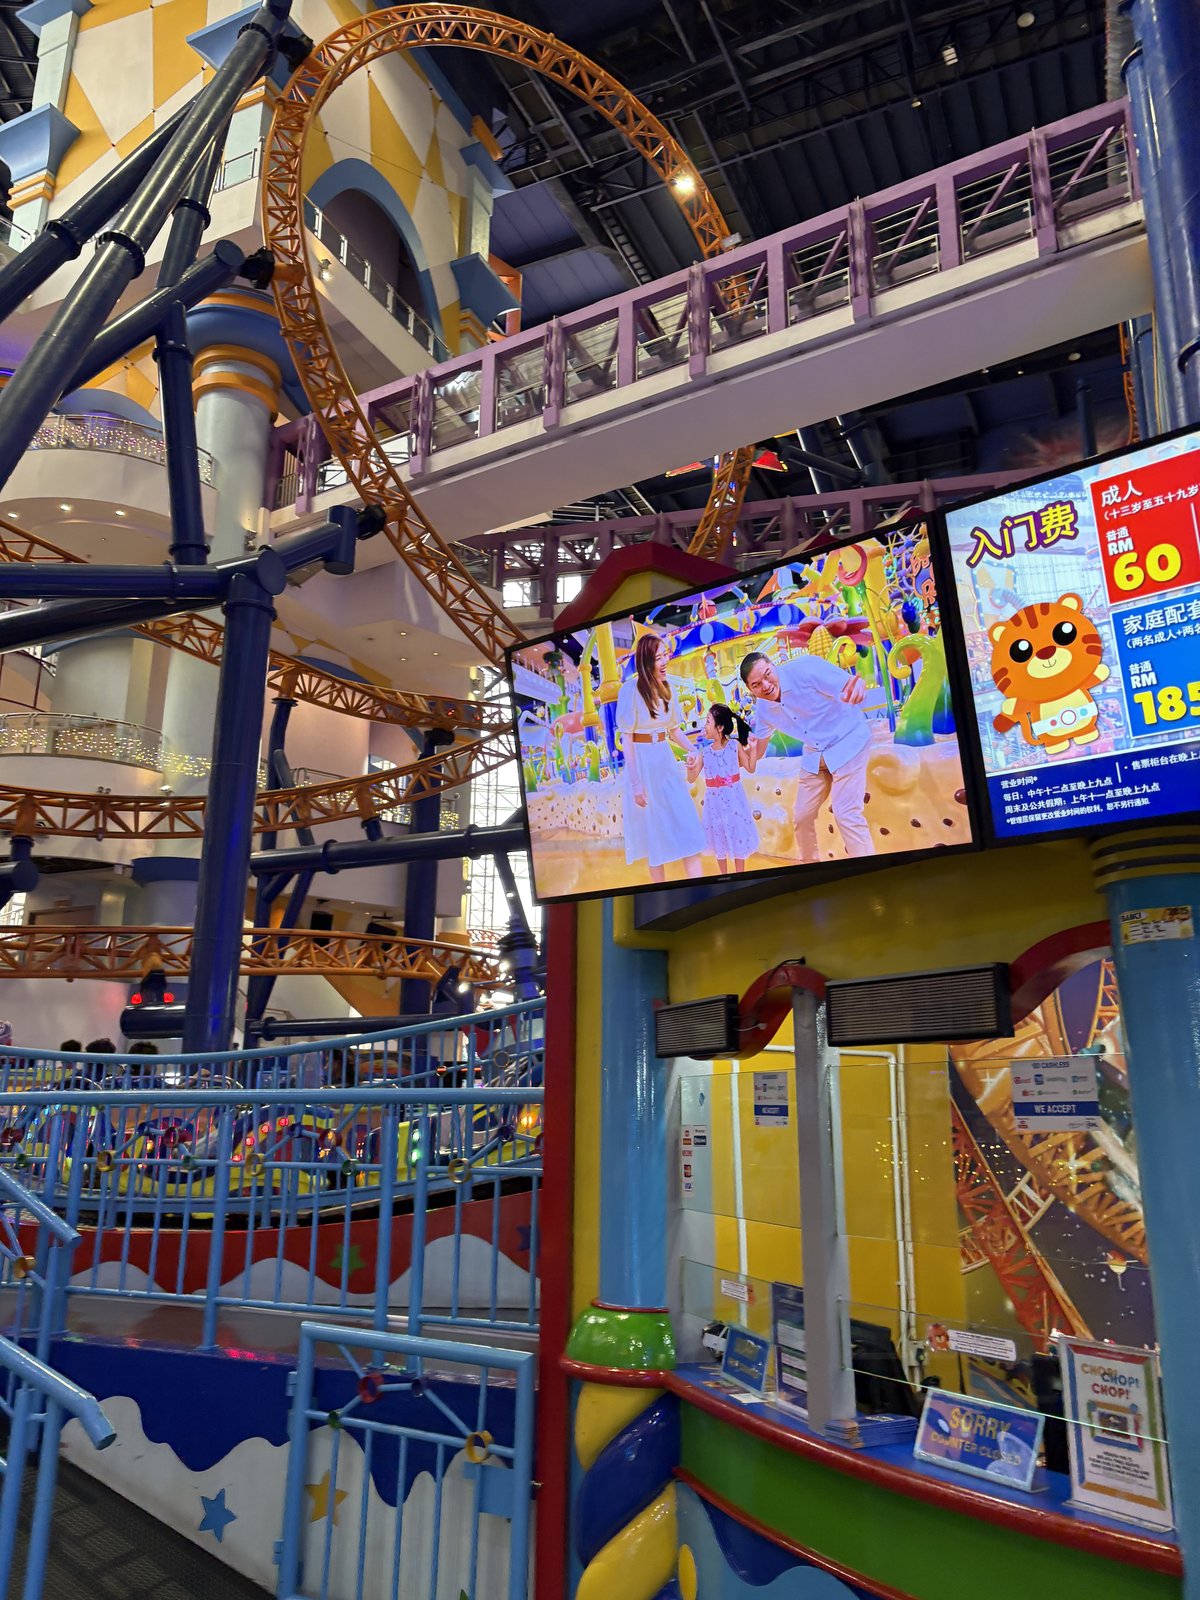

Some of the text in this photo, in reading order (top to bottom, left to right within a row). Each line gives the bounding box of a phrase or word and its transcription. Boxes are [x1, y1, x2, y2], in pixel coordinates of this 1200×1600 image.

[1101, 480, 1142, 507] 成人
[1104, 482, 1200, 520] (十三岁至五十九岁
[968, 502, 1077, 566] 入门费
[1106, 526, 1129, 542] 普通
[1107, 538, 1134, 556] RM
[1113, 543, 1182, 591] 60
[1129, 661, 1153, 675] 普通
[1130, 672, 1158, 689] RM
[1132, 751, 1200, 770] 售票柜台在晚上
[1041, 1061, 1070, 1069] CASHLESS
[1033, 1104, 1077, 1114] WE ACCEPT
[1101, 1372, 1141, 1388] CHOP!
[1091, 1383, 1130, 1400] CHOP!
[949, 1407, 1012, 1441] SORRY
